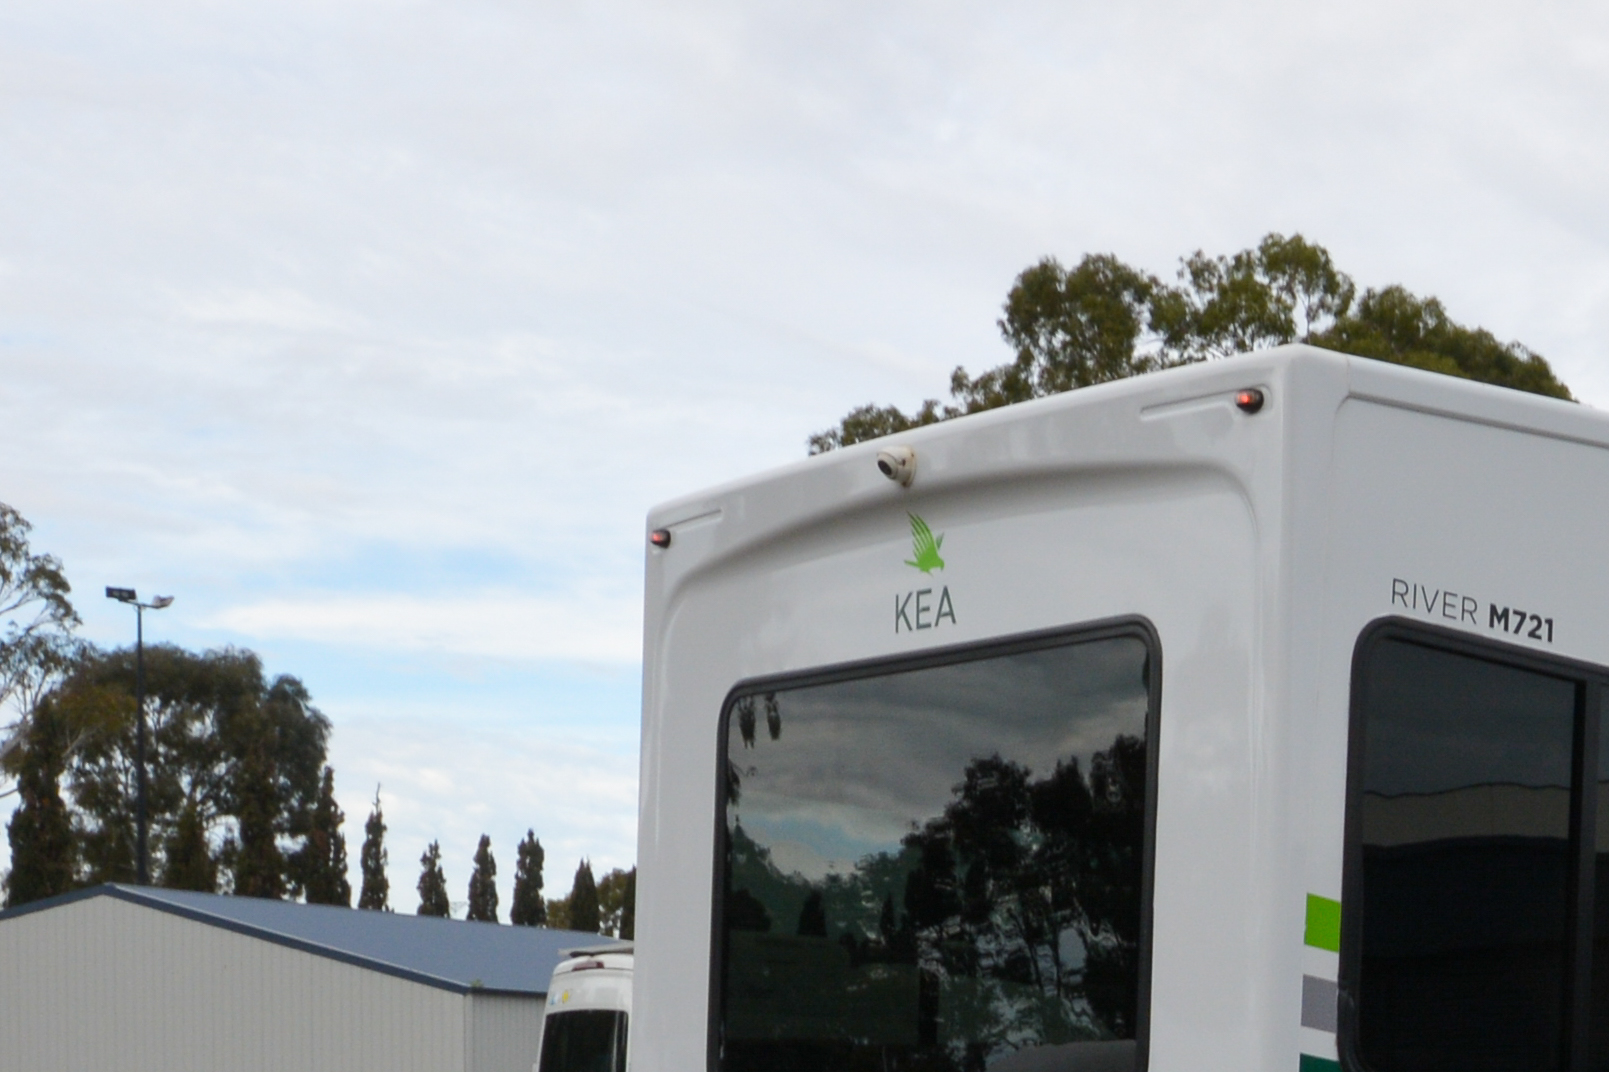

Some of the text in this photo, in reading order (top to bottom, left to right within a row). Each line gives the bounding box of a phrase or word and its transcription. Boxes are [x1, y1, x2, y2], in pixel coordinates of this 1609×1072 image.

[895, 584, 957, 634] KEA
[1391, 577, 1554, 643] RIVER M721
